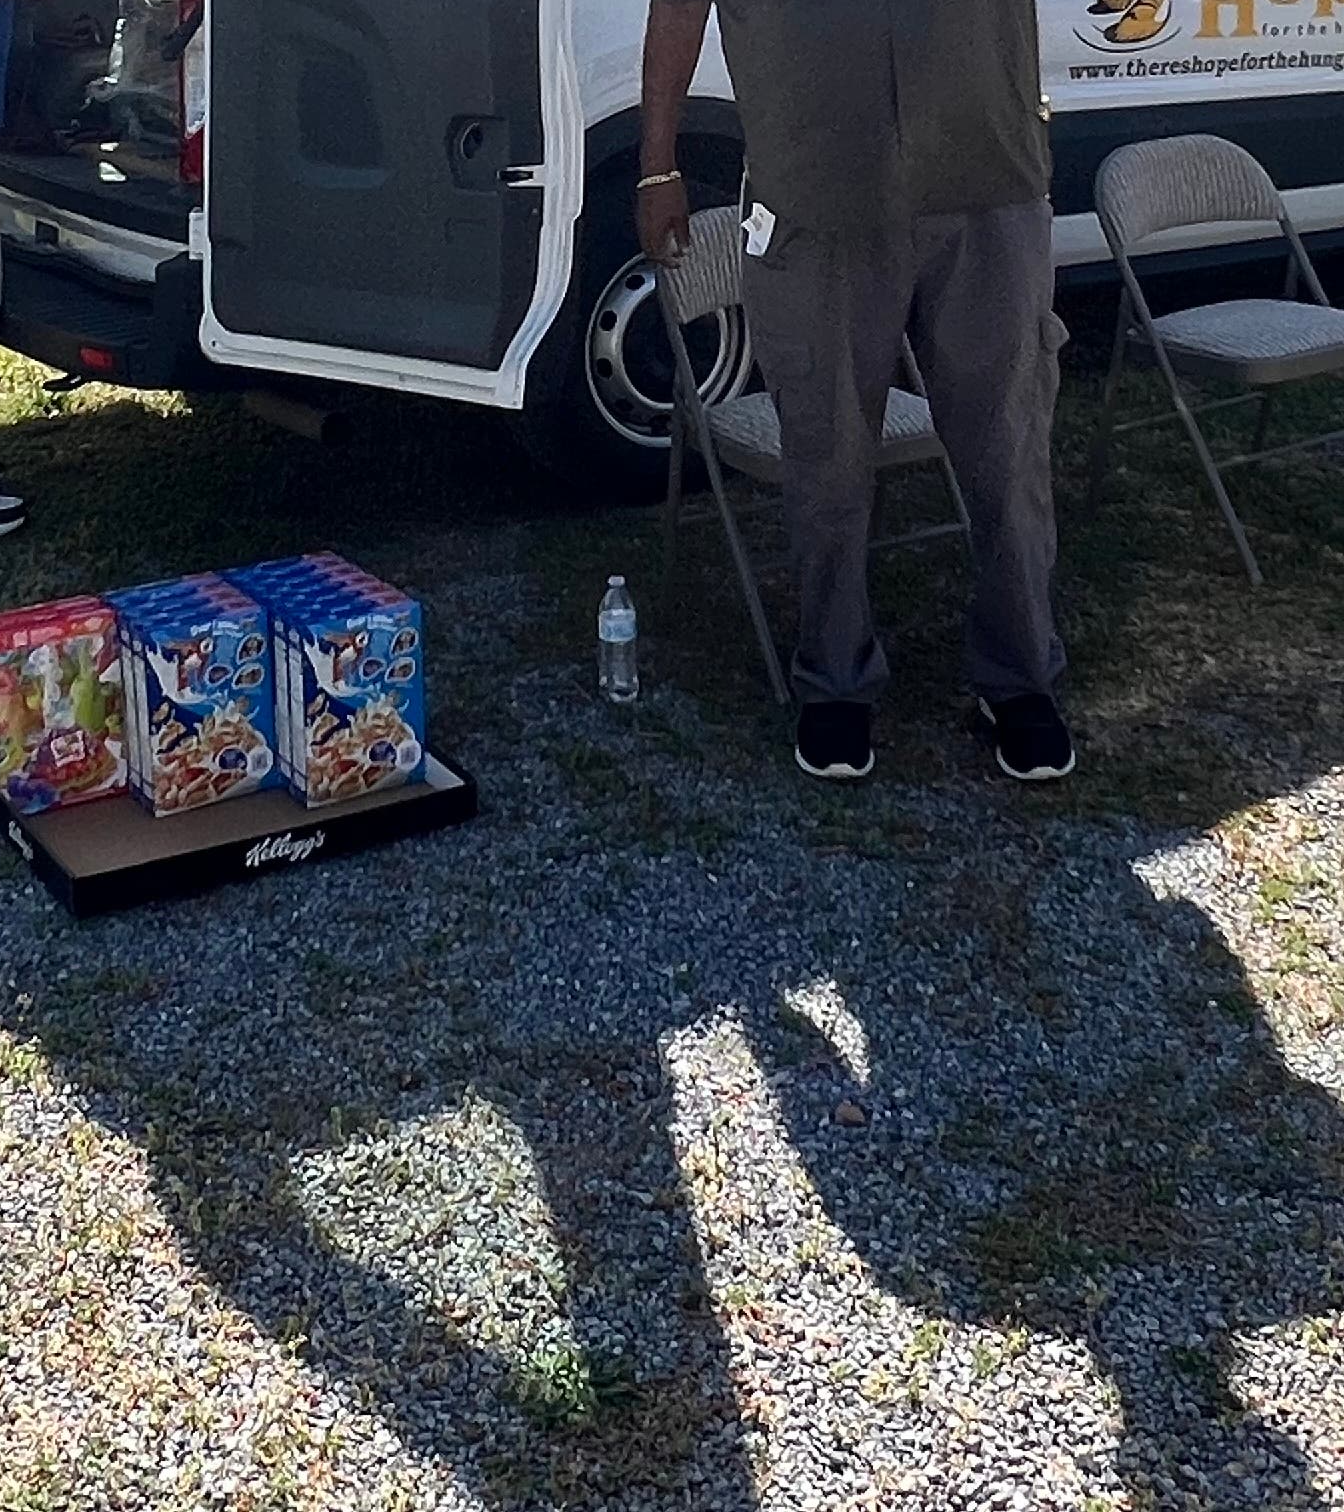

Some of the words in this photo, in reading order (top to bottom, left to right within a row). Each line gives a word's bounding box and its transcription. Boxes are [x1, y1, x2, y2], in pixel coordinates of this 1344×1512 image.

[1262, 22, 1290, 37] for
[1298, 22, 1327, 37] the
[246, 830, 326, 867] Kellogg's
